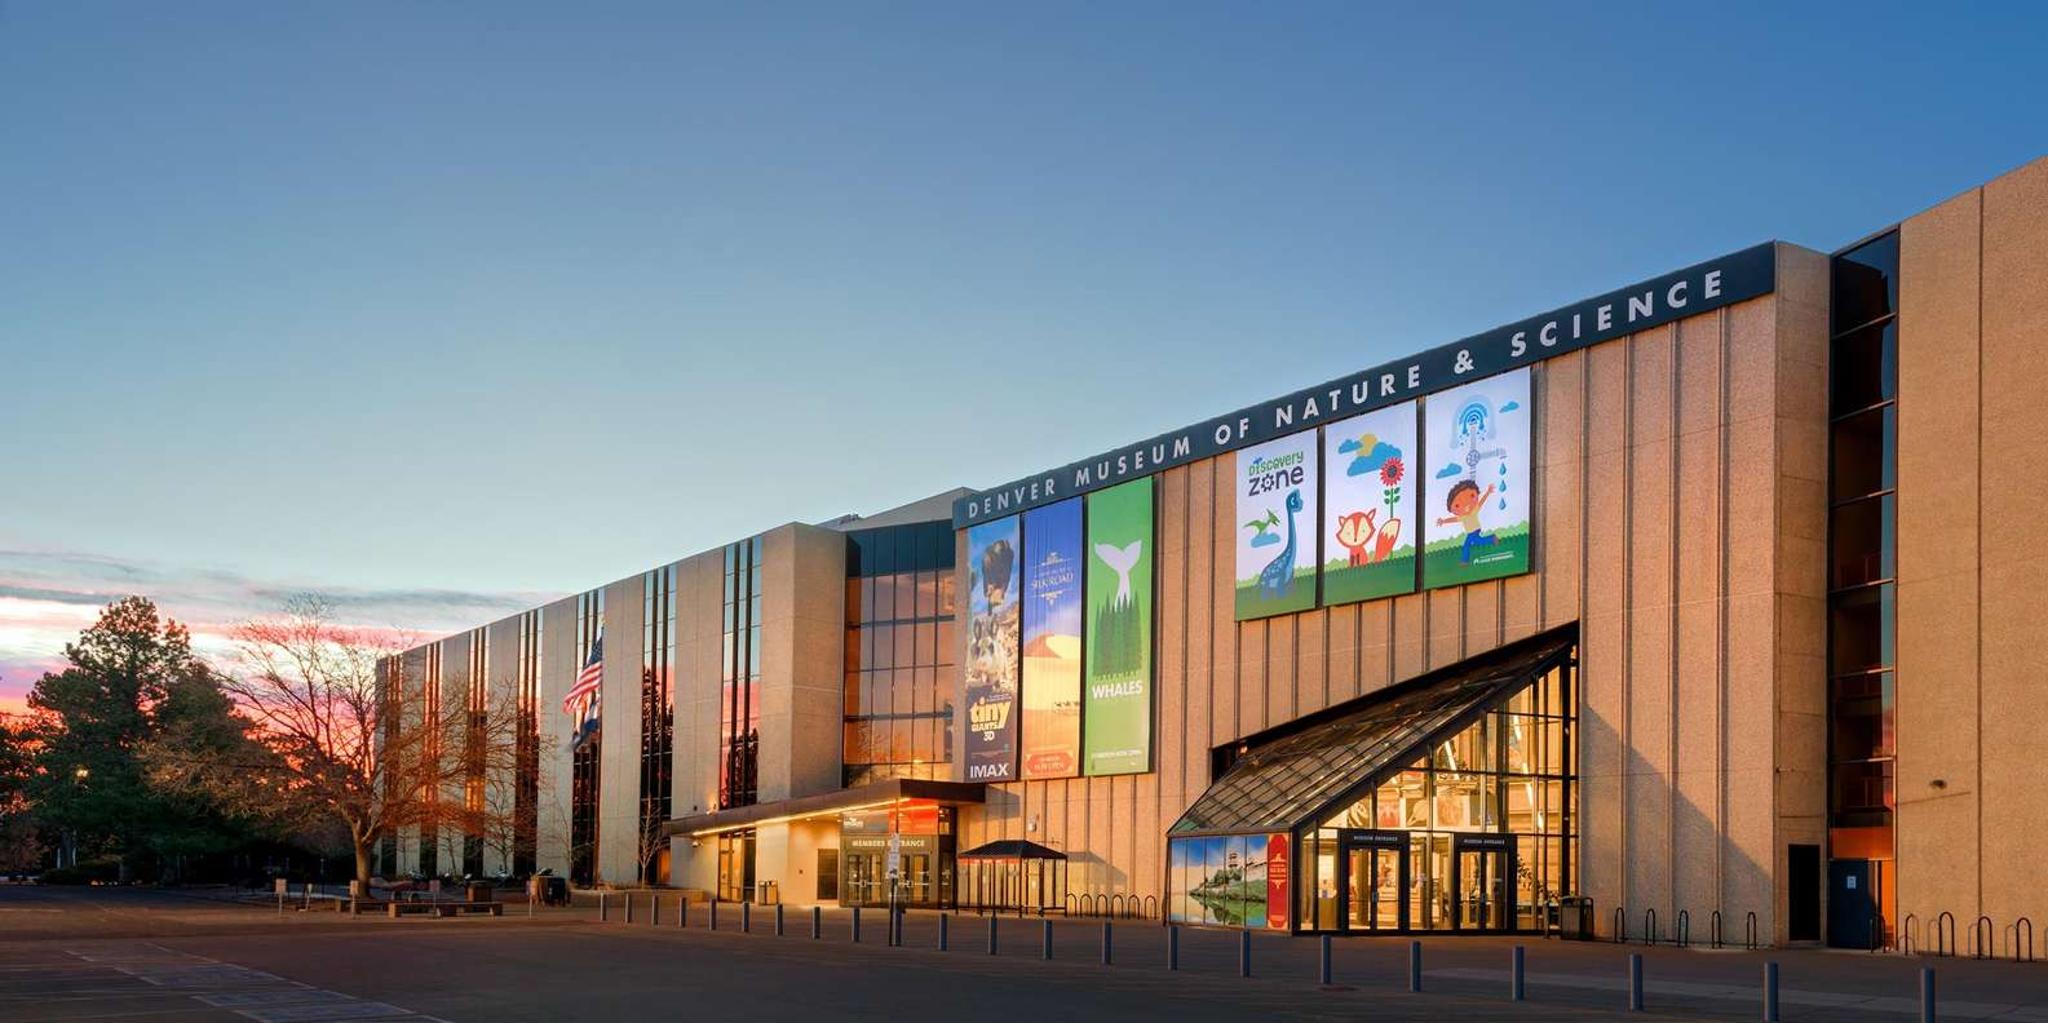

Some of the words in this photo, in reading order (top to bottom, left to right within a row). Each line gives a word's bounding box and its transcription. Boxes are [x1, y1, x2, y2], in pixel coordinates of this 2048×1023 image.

[968, 478, 1055, 518] DENVER
[1074, 436, 1190, 488] MUSEUM
[1214, 418, 1249, 445] OF
[1275, 365, 1420, 428] NATURE
[1453, 349, 1475, 375] &
[1511, 270, 1721, 357] SCIENCE
[1092, 679, 1143, 699] WHALES
[969, 696, 1012, 730] tiny
[983, 730, 995, 742] 3D
[969, 763, 1009, 779] IMAX
[887, 839, 925, 847] ERANCE
